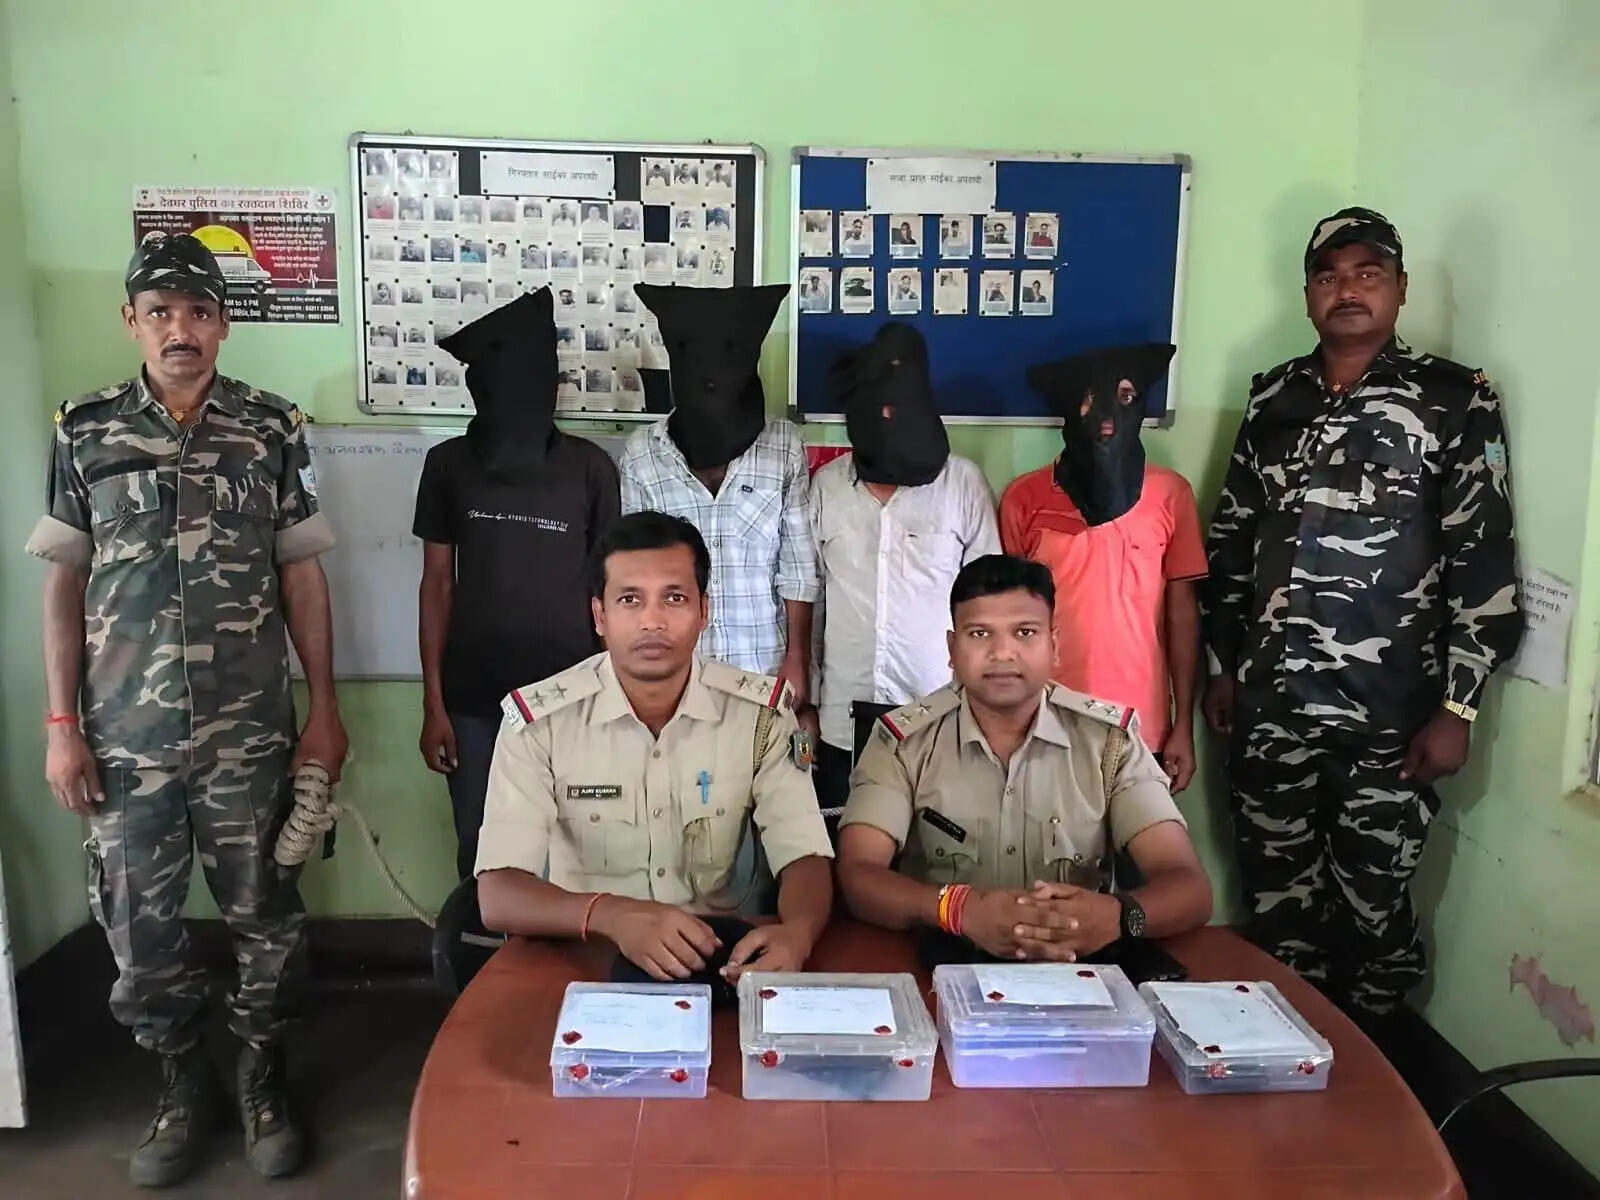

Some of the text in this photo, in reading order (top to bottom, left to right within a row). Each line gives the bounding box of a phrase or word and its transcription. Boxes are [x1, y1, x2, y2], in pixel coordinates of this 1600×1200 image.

[160, 196, 187, 208] देवघर
[189, 196, 217, 210] पुलिस
[221, 199, 235, 208] का
[279, 197, 309, 209] शिविर
